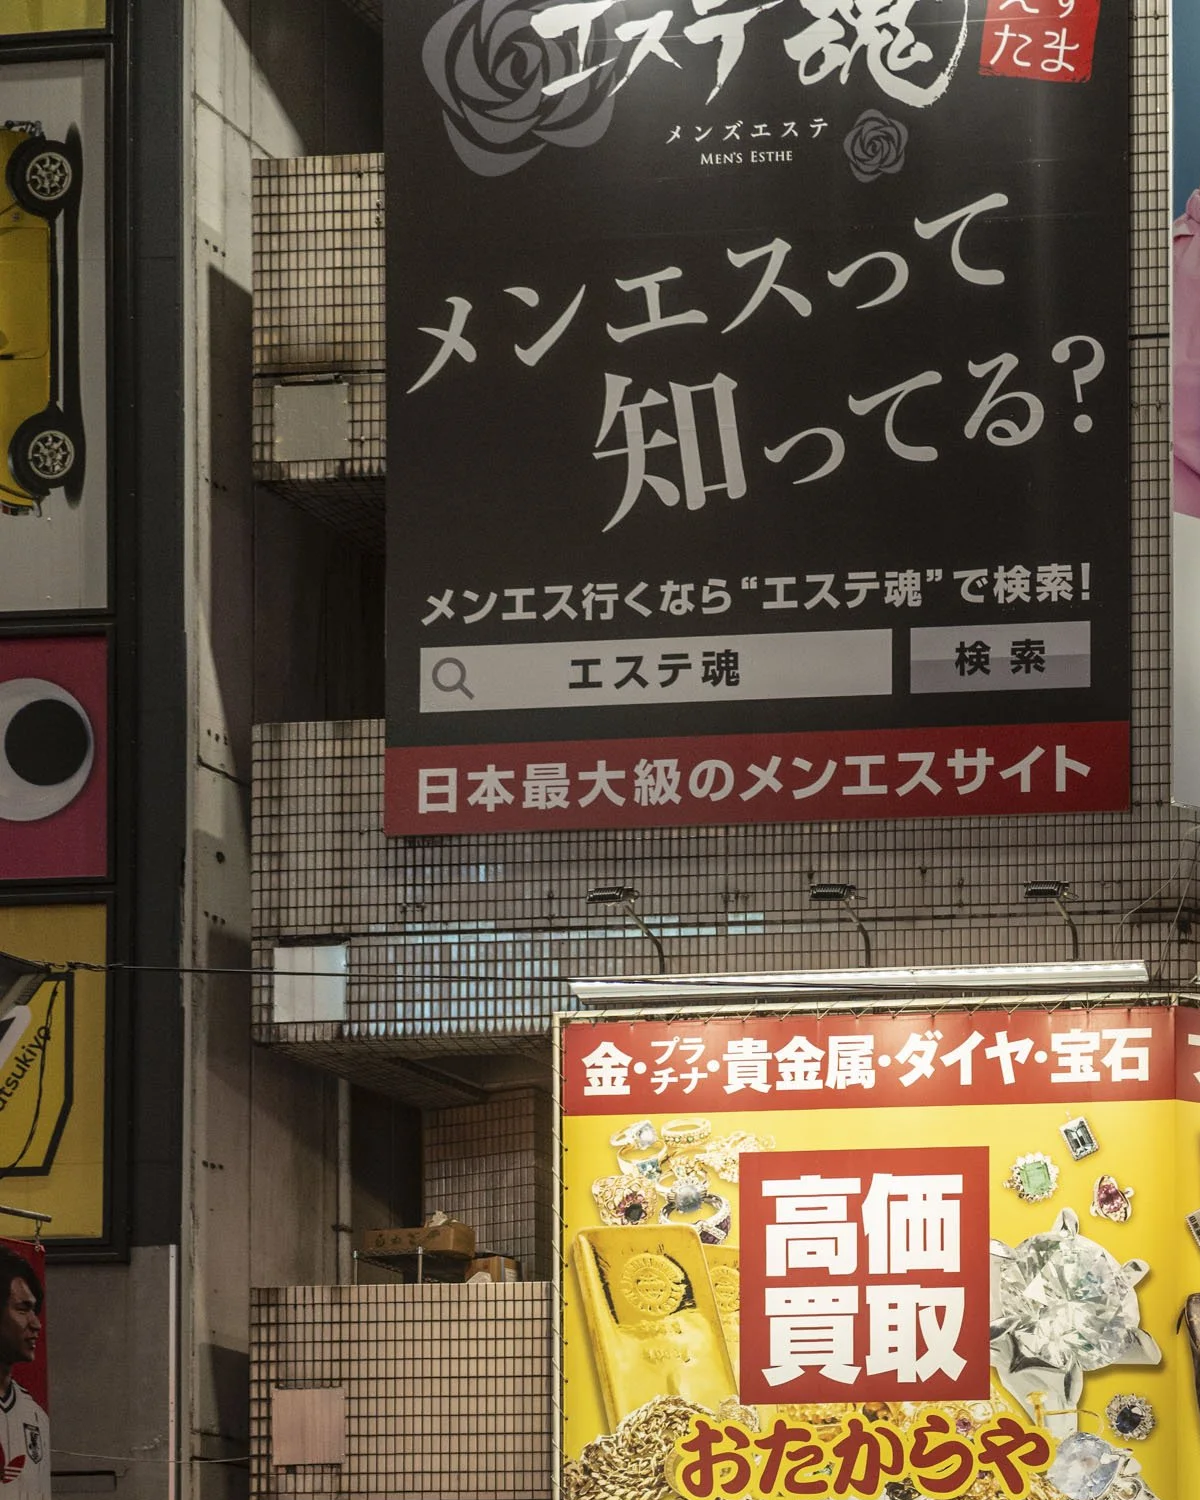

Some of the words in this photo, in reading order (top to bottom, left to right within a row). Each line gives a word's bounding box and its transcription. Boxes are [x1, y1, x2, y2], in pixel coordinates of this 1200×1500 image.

[665, 117, 830, 145] メンズエステ
[700, 152, 743, 165] MEN'S
[750, 149, 793, 163] ESTHE
[406, 192, 1010, 394] メンエスって
[592, 335, 1107, 533] 知ってる?
[568, 649, 742, 689] エステ魂
[417, 744, 1092, 815] 日本最大級のメンエスサイト
[761, 1173, 965, 1277] 高価
[761, 1285, 969, 1387] 買取
[679, 1414, 1051, 1498] おたからや
